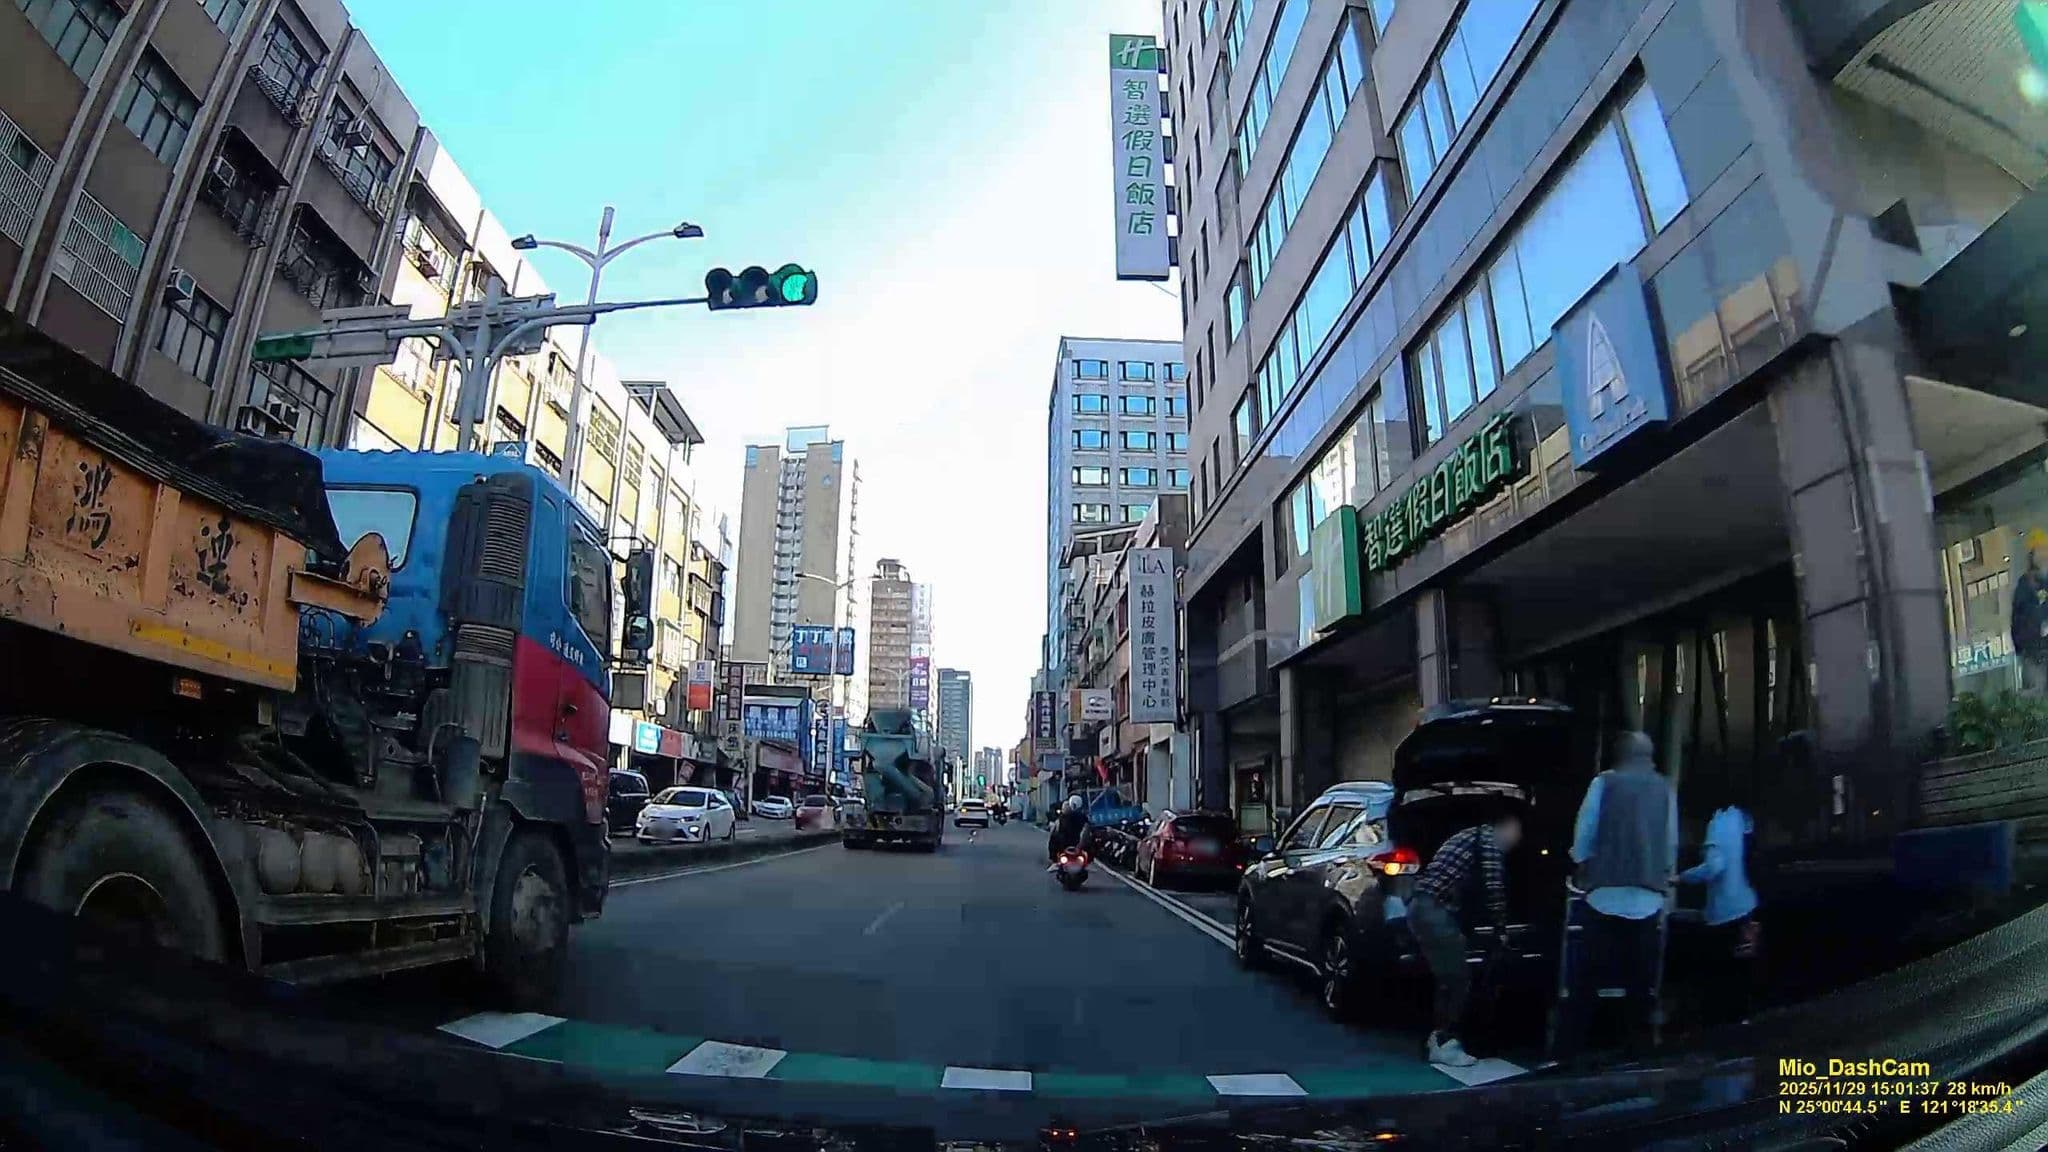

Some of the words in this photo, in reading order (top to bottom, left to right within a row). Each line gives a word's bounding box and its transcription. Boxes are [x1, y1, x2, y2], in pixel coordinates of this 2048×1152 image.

[1122, 79, 1155, 235] 智選假日飯店
[1363, 412, 1514, 571] 智選假日飯店
[1140, 584, 1157, 709] 赫拉皮膚管理中心
